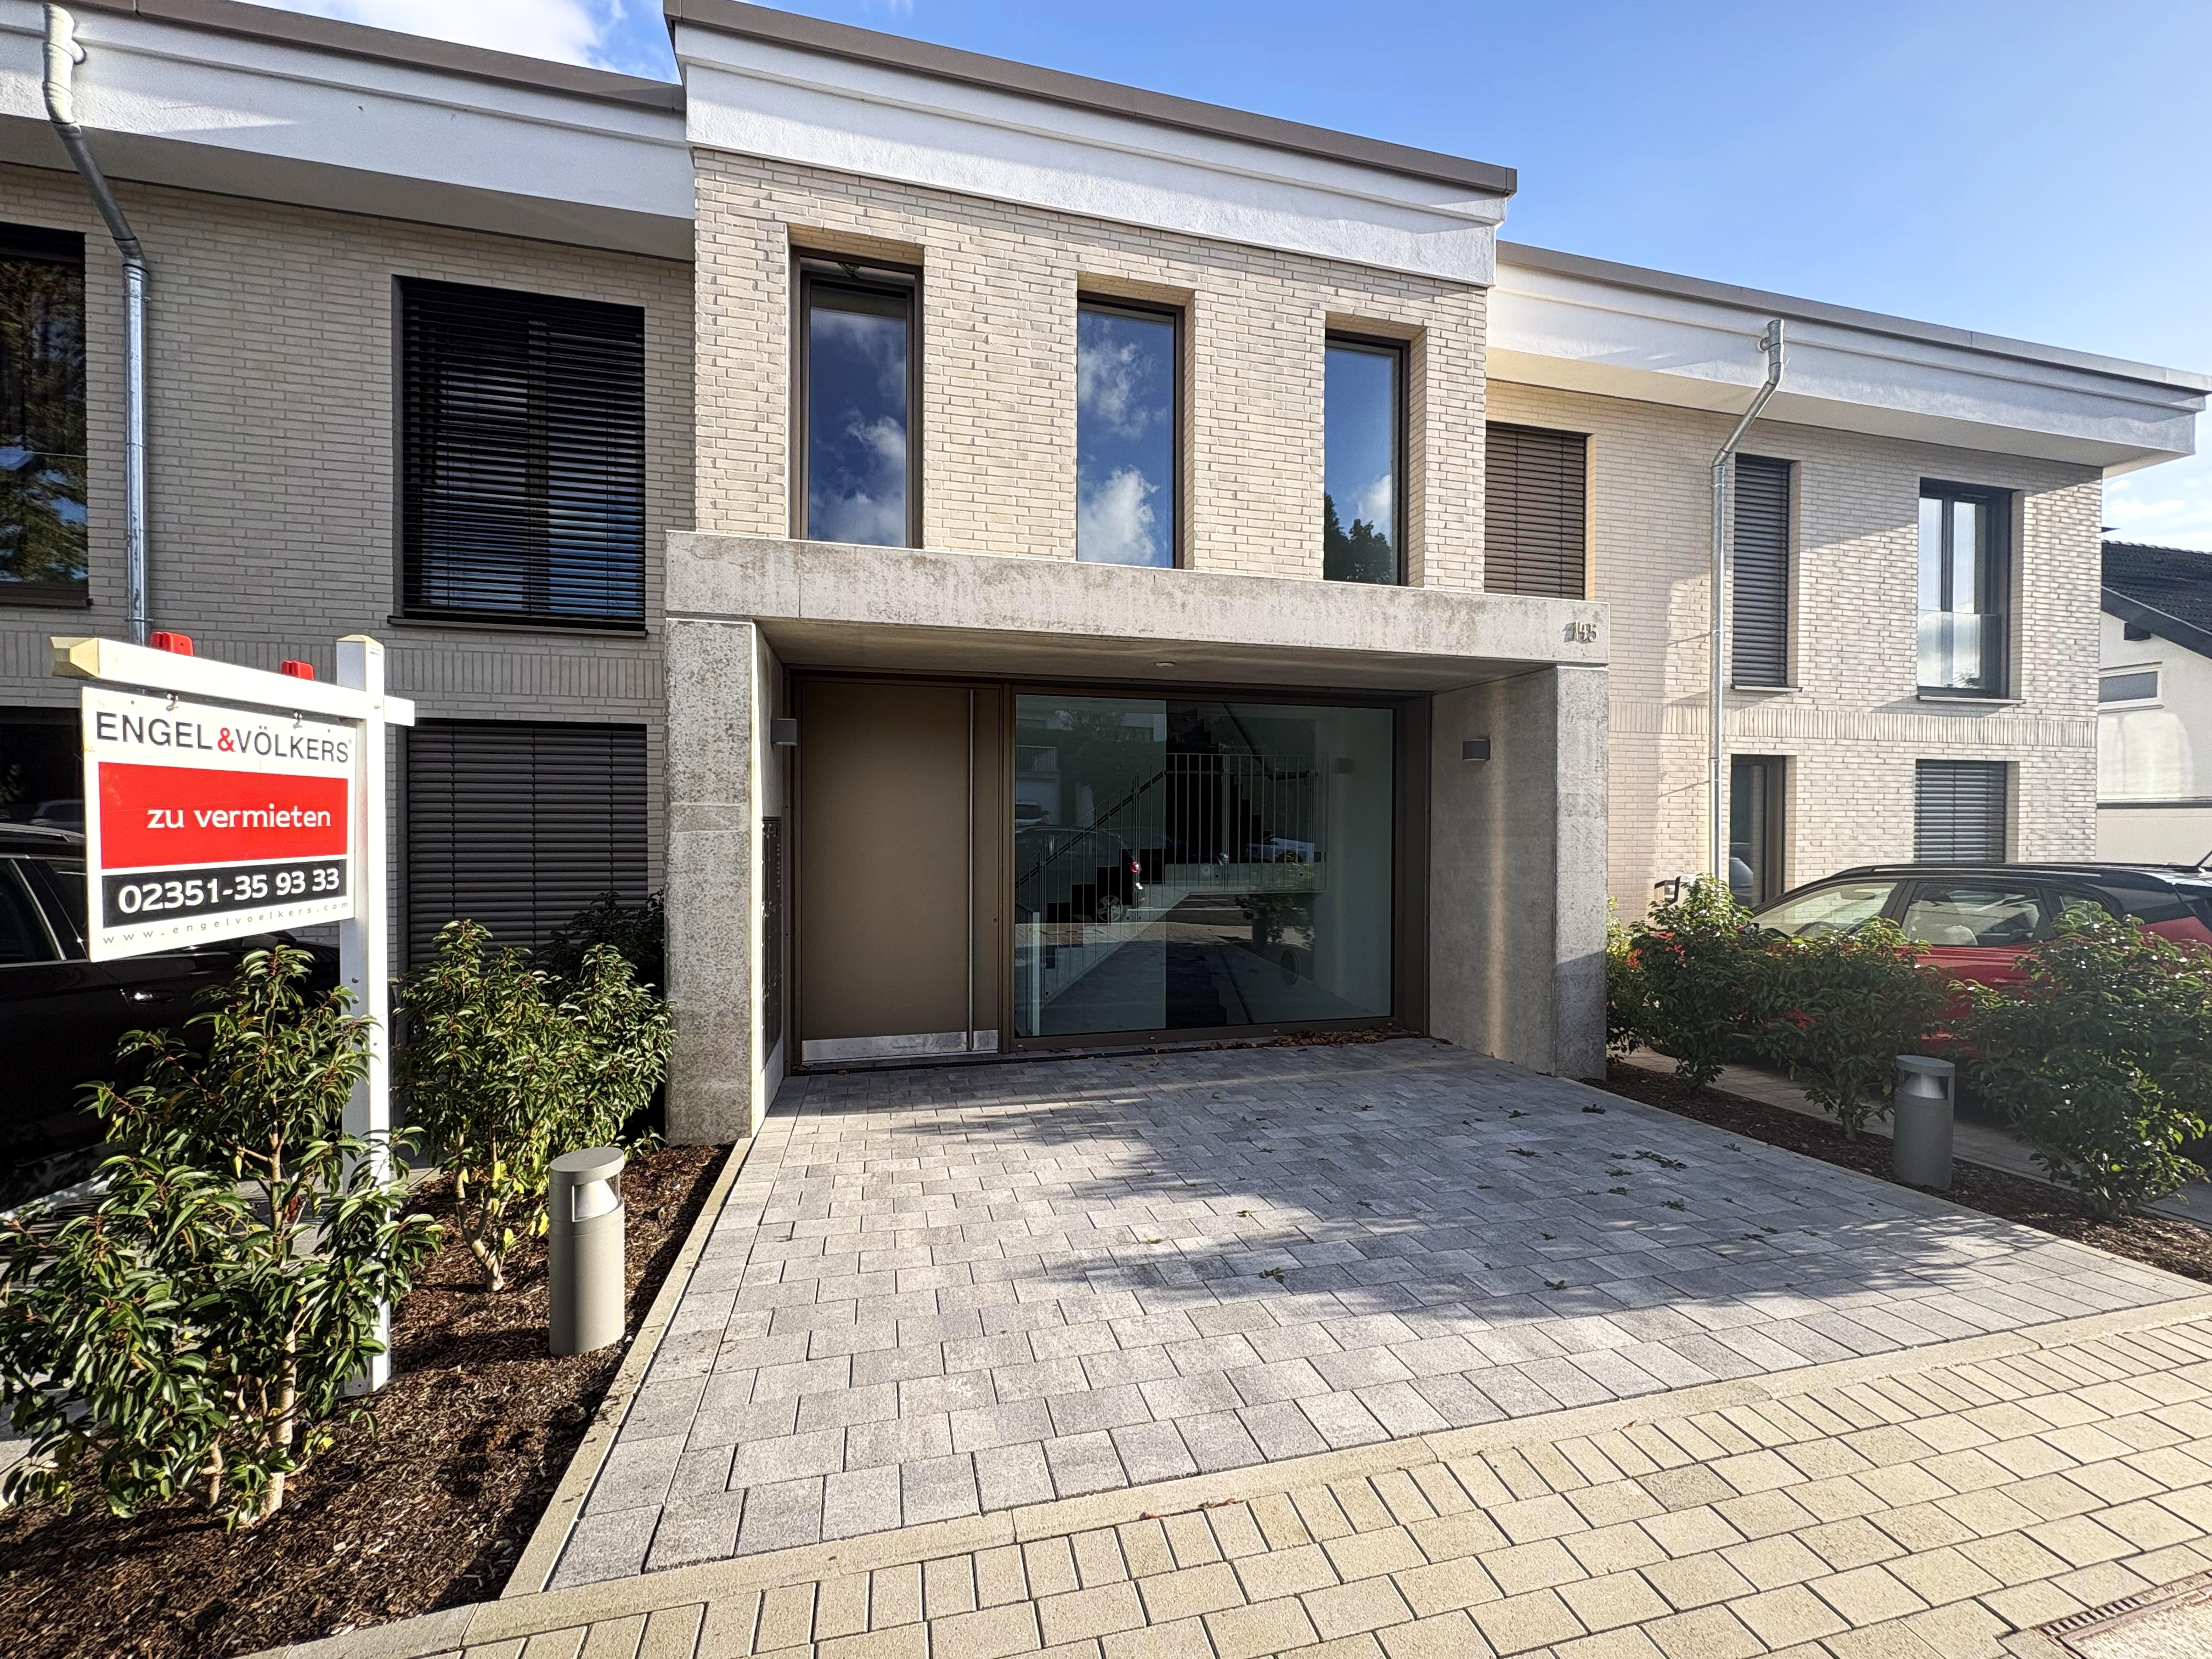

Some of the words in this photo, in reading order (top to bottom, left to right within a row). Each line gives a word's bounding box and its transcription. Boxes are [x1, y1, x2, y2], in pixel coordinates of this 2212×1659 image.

[147, 810, 184, 828] zu
[194, 803, 331, 828] vermieten
[118, 874, 268, 913] 02351-35
[275, 871, 306, 895] 93
[311, 868, 340, 891] 33
[103, 901, 348, 944] www.engelvoelkers.com
